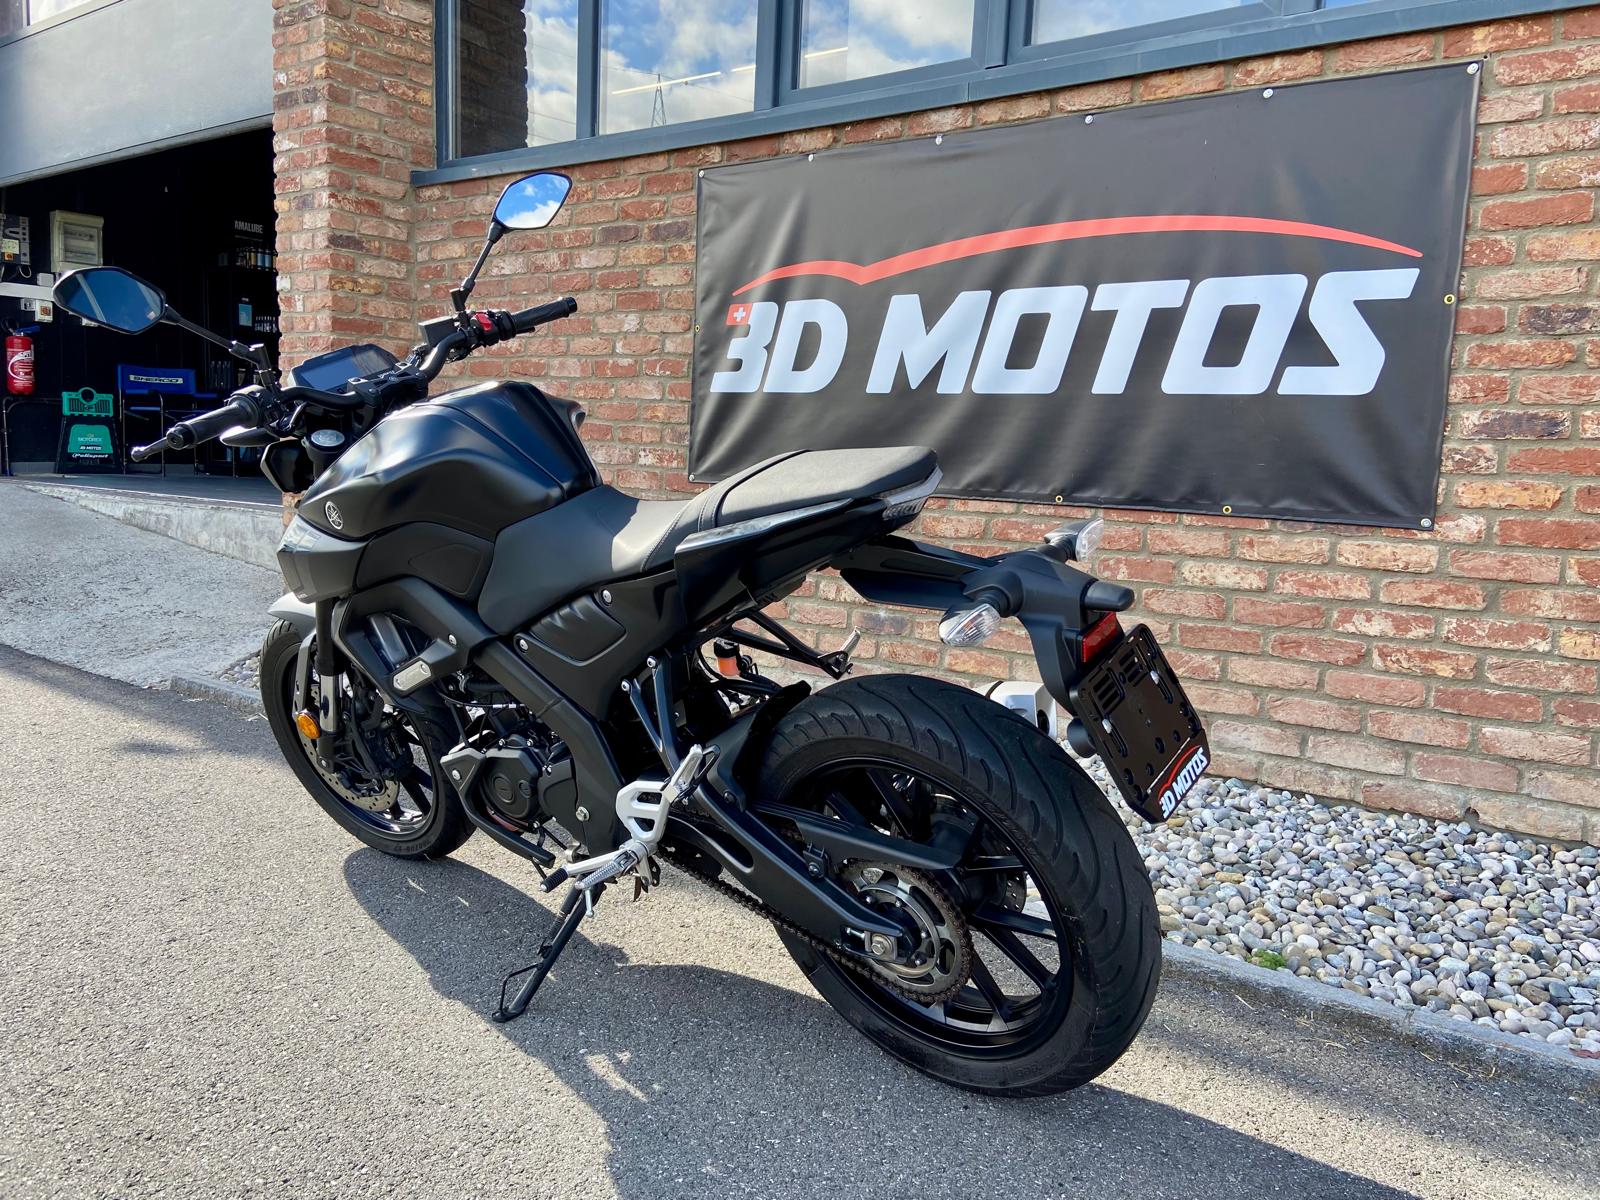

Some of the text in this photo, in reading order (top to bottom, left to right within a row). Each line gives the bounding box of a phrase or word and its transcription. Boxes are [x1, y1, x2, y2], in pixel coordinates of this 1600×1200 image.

[235, 220, 263, 233] AMALUBE
[710, 268, 1420, 396] 3D MOTOS
[1159, 747, 1208, 819] 3D MOTOS
